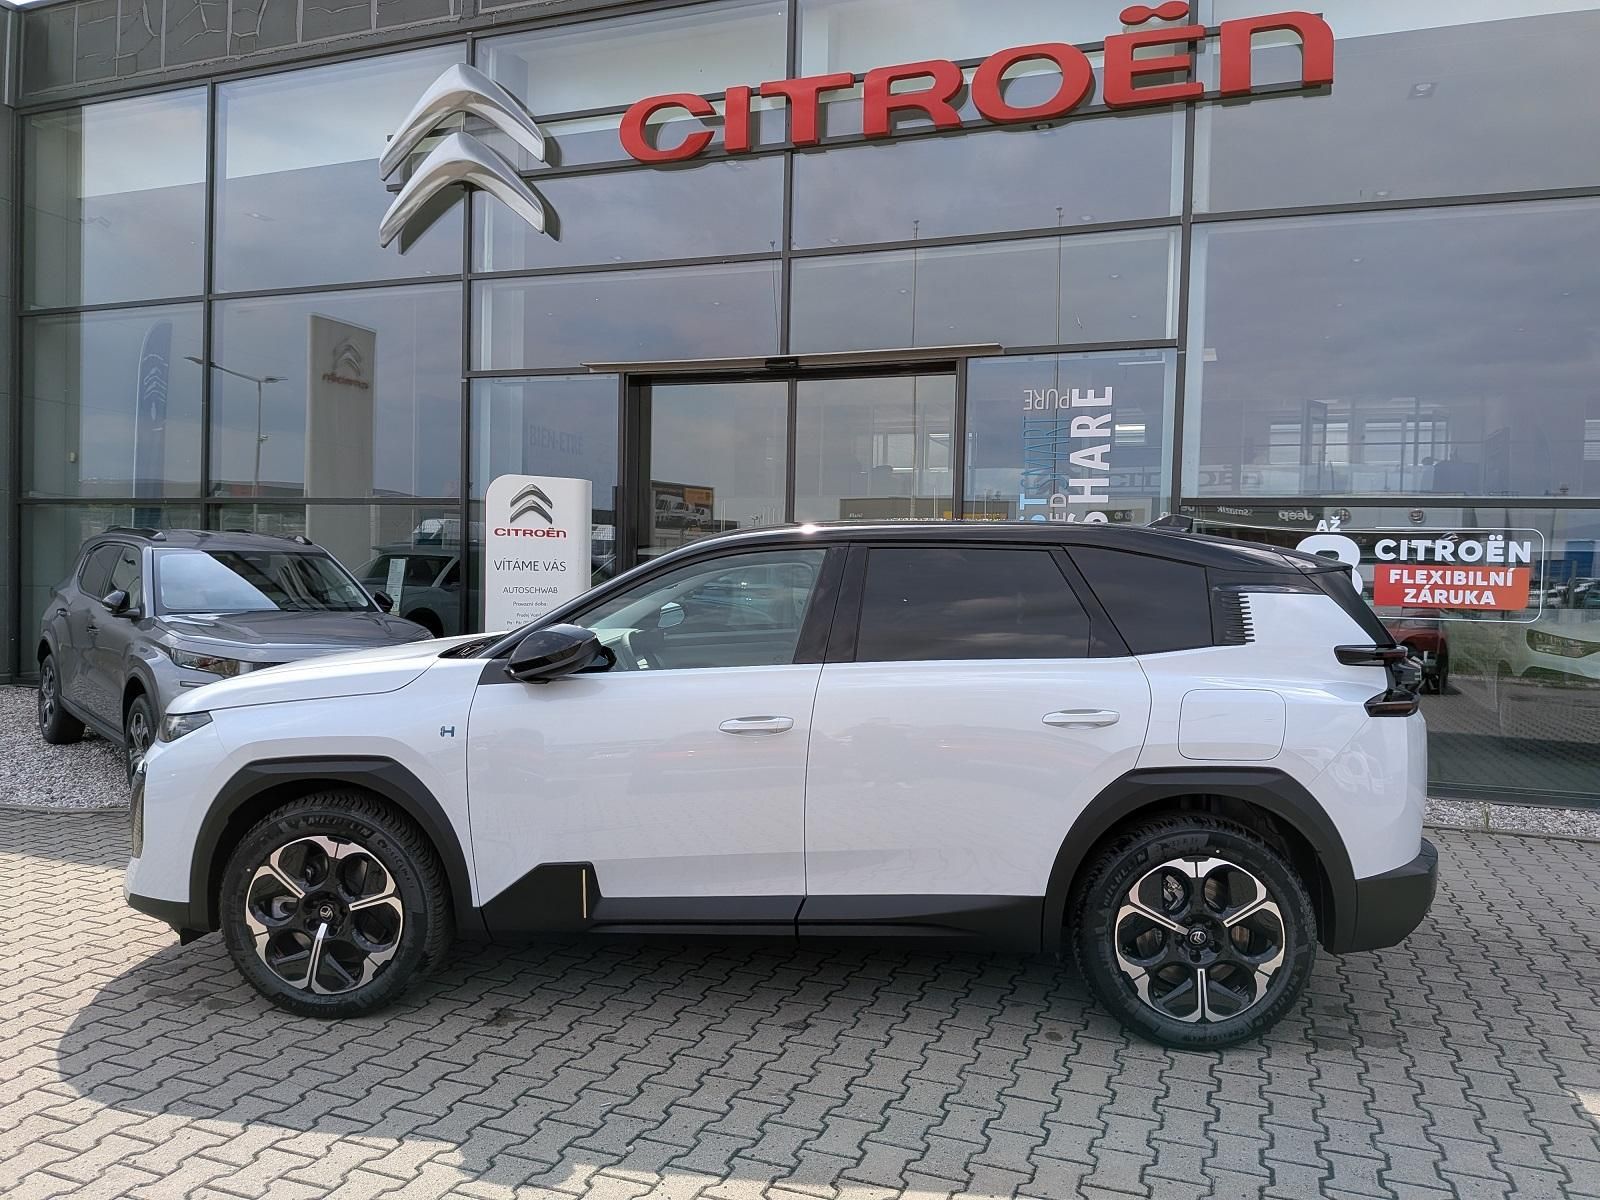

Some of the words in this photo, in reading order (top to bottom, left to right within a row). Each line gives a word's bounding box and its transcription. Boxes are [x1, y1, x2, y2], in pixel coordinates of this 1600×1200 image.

[619, 1, 1334, 163] CITROËN
[1023, 387, 1072, 410] PURE
[1020, 416, 1071, 490] SMART
[494, 527, 567, 539] CITROËN
[1315, 515, 1341, 532] AŽ
[1374, 534, 1531, 564] CITROËN
[494, 557, 539, 572] VÍTÁME
[543, 558, 567, 572] VÁS
[1389, 568, 1514, 587] FLEXIBILNÍ
[502, 586, 559, 594] AUTOSCHWAB
[1403, 585, 1496, 606] ZÁRUKA
[307, 815, 376, 840] MICHLIN
